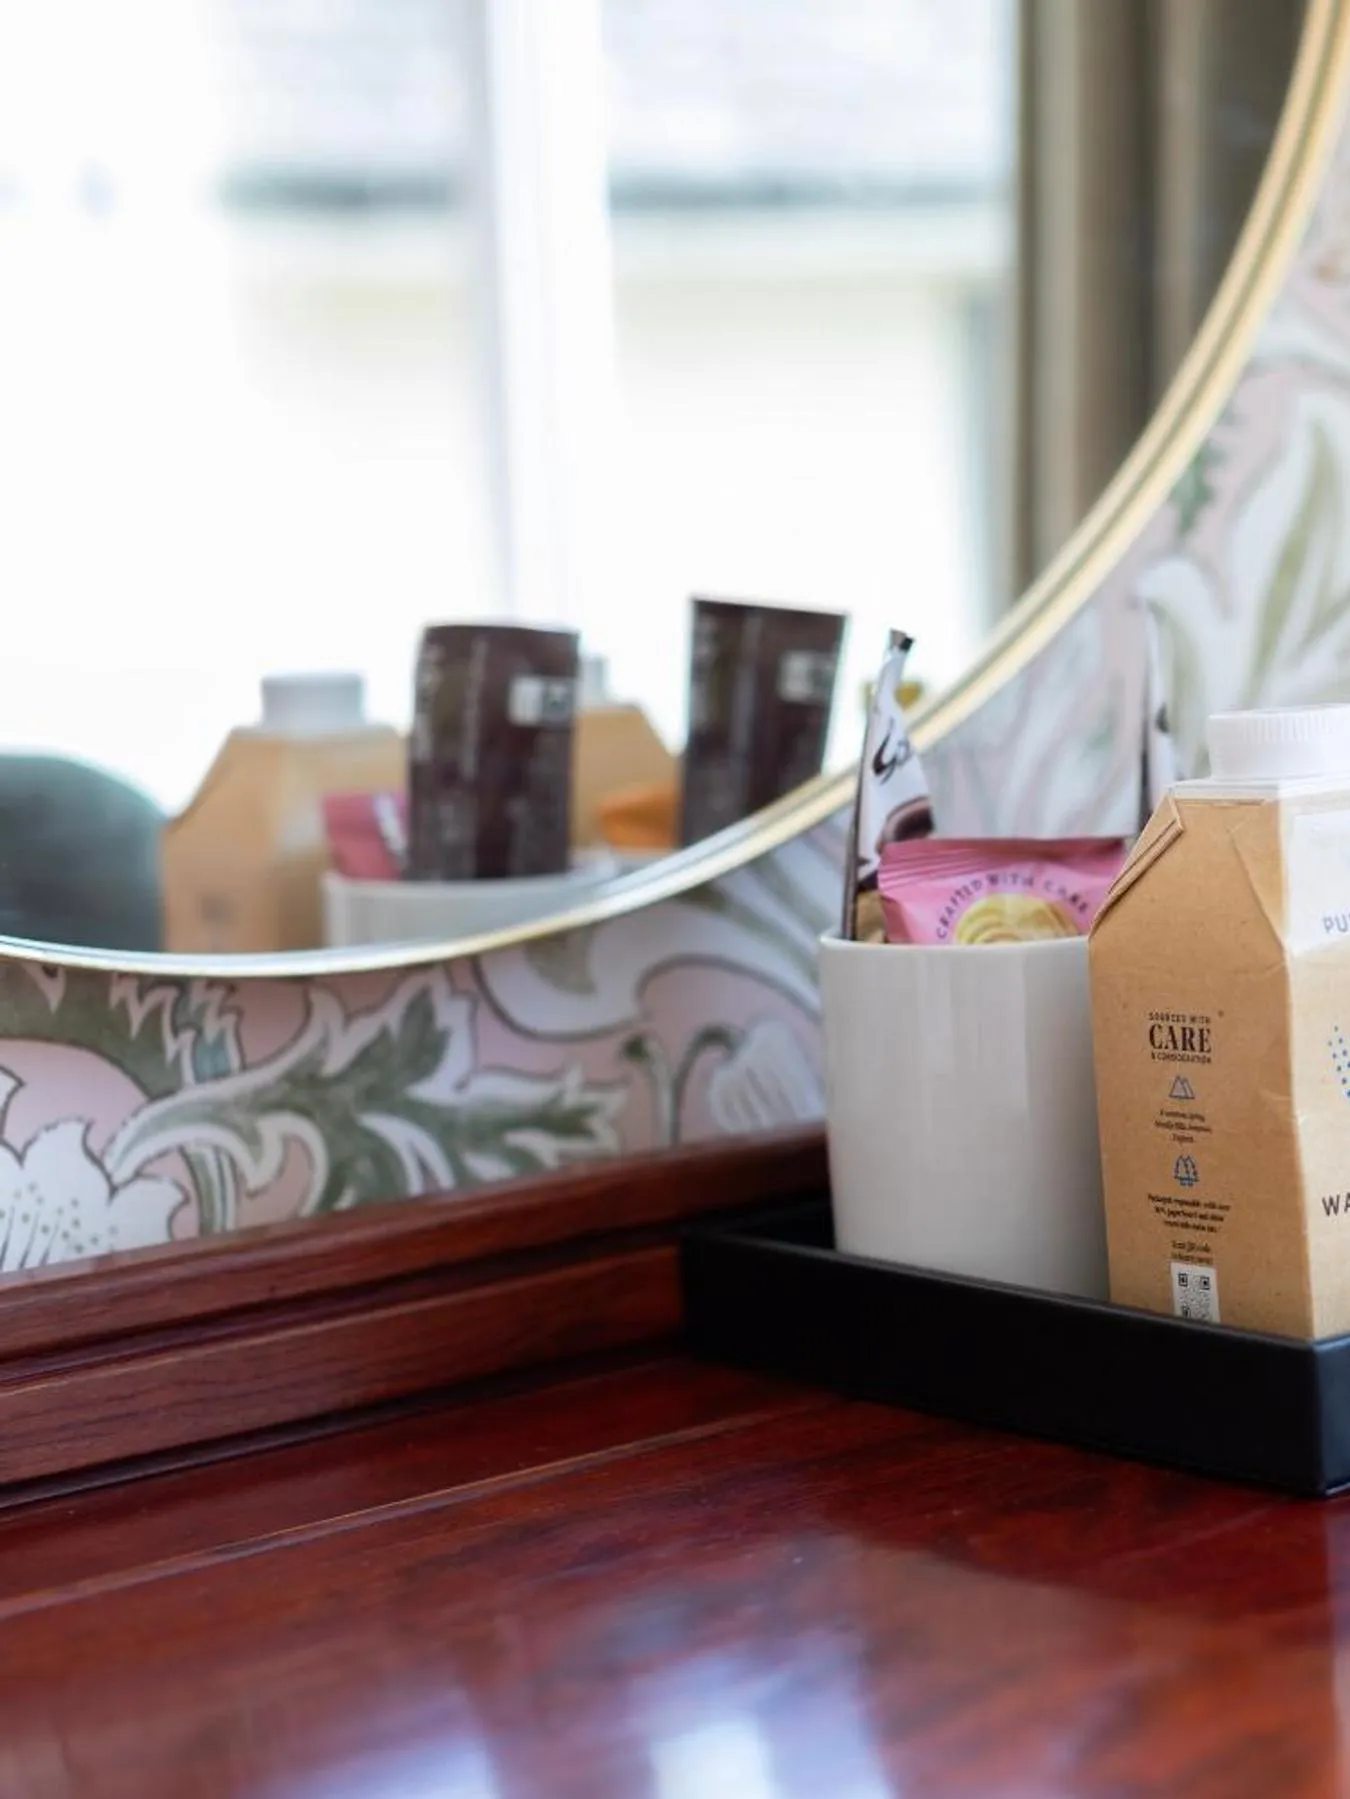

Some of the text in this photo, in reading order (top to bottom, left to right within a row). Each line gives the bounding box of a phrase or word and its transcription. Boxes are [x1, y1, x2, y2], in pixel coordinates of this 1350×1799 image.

[936, 879, 983, 940] CRAFTED
[985, 872, 1034, 888] WITH
[1148, 1023, 1212, 1054] CARE
